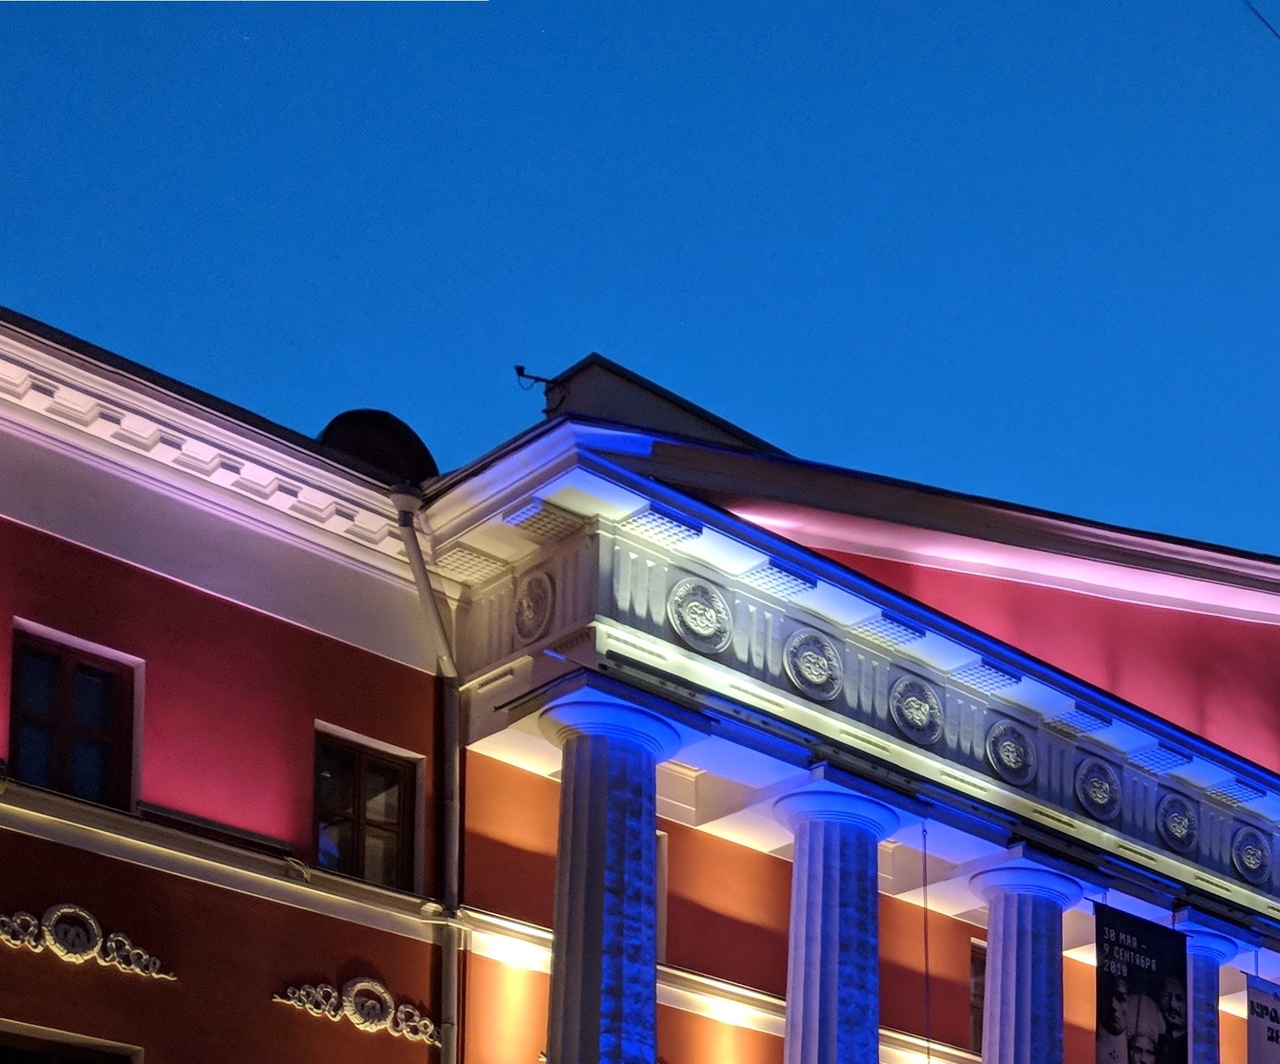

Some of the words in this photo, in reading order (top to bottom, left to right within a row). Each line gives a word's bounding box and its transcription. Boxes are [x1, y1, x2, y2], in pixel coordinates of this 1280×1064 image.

[1119, 932, 1138, 949] МАЯ
[1103, 943, 1110, 955] 9
[1114, 946, 1156, 972] СЕНТЯБРЯ
[1103, 959, 1128, 977] 2018
